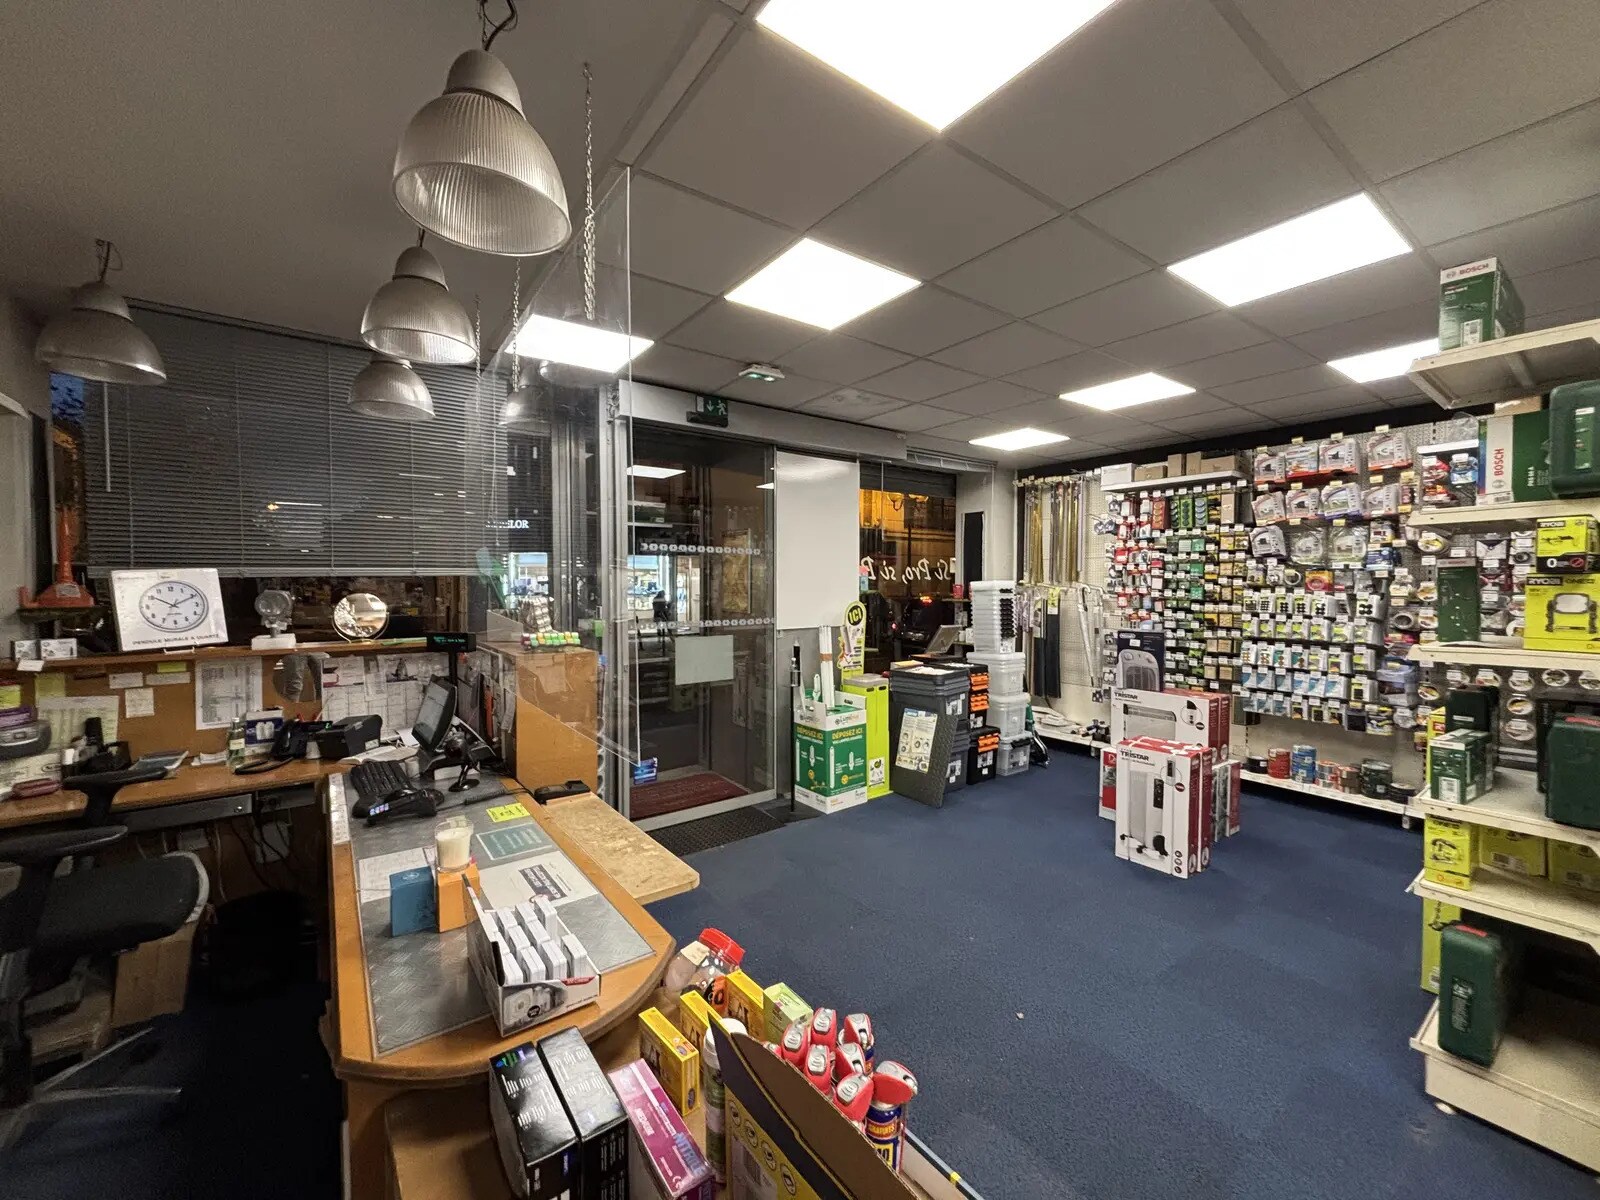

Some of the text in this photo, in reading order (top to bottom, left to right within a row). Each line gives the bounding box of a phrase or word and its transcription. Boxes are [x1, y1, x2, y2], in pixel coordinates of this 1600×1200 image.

[1459, 263, 1489, 275] BOSCH
[1493, 448, 1504, 477] BOSCH
[1546, 557, 1558, 569] 0
[849, 607, 862, 624] ICI
[1120, 750, 1150, 761] TRISTAR
